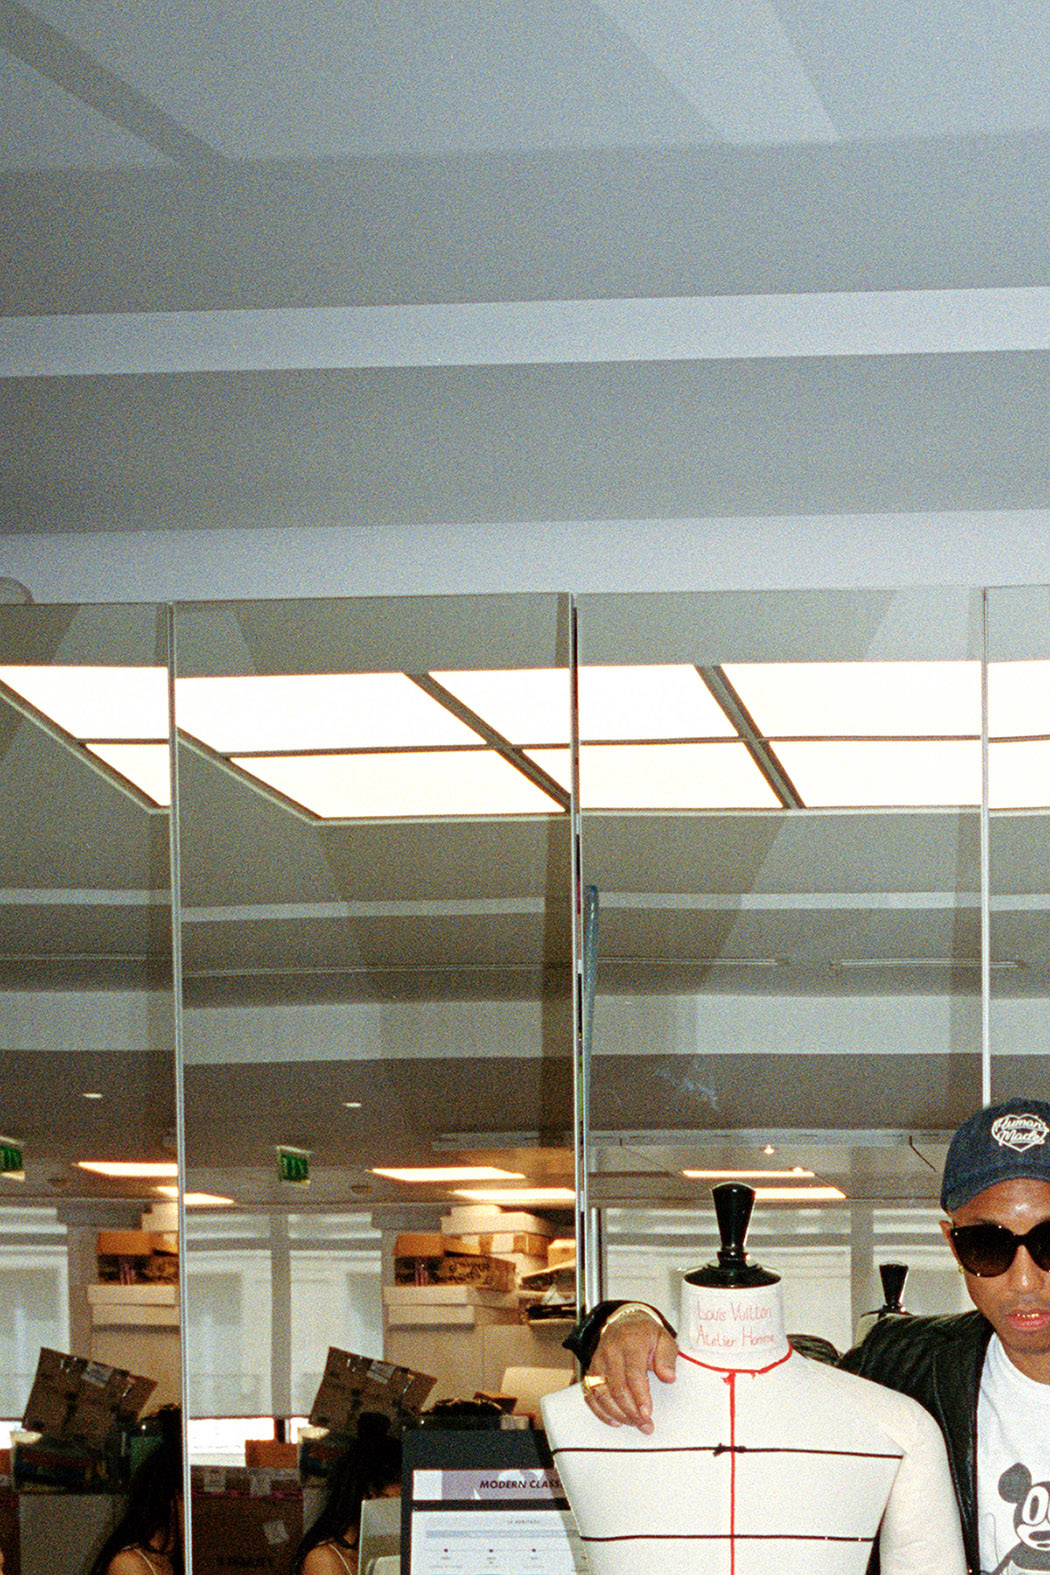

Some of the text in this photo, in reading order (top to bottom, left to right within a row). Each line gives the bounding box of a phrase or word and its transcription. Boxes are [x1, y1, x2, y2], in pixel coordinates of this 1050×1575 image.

[697, 1299, 772, 1321] Louis Vuitton
[479, 1479, 526, 1489] MODERN
